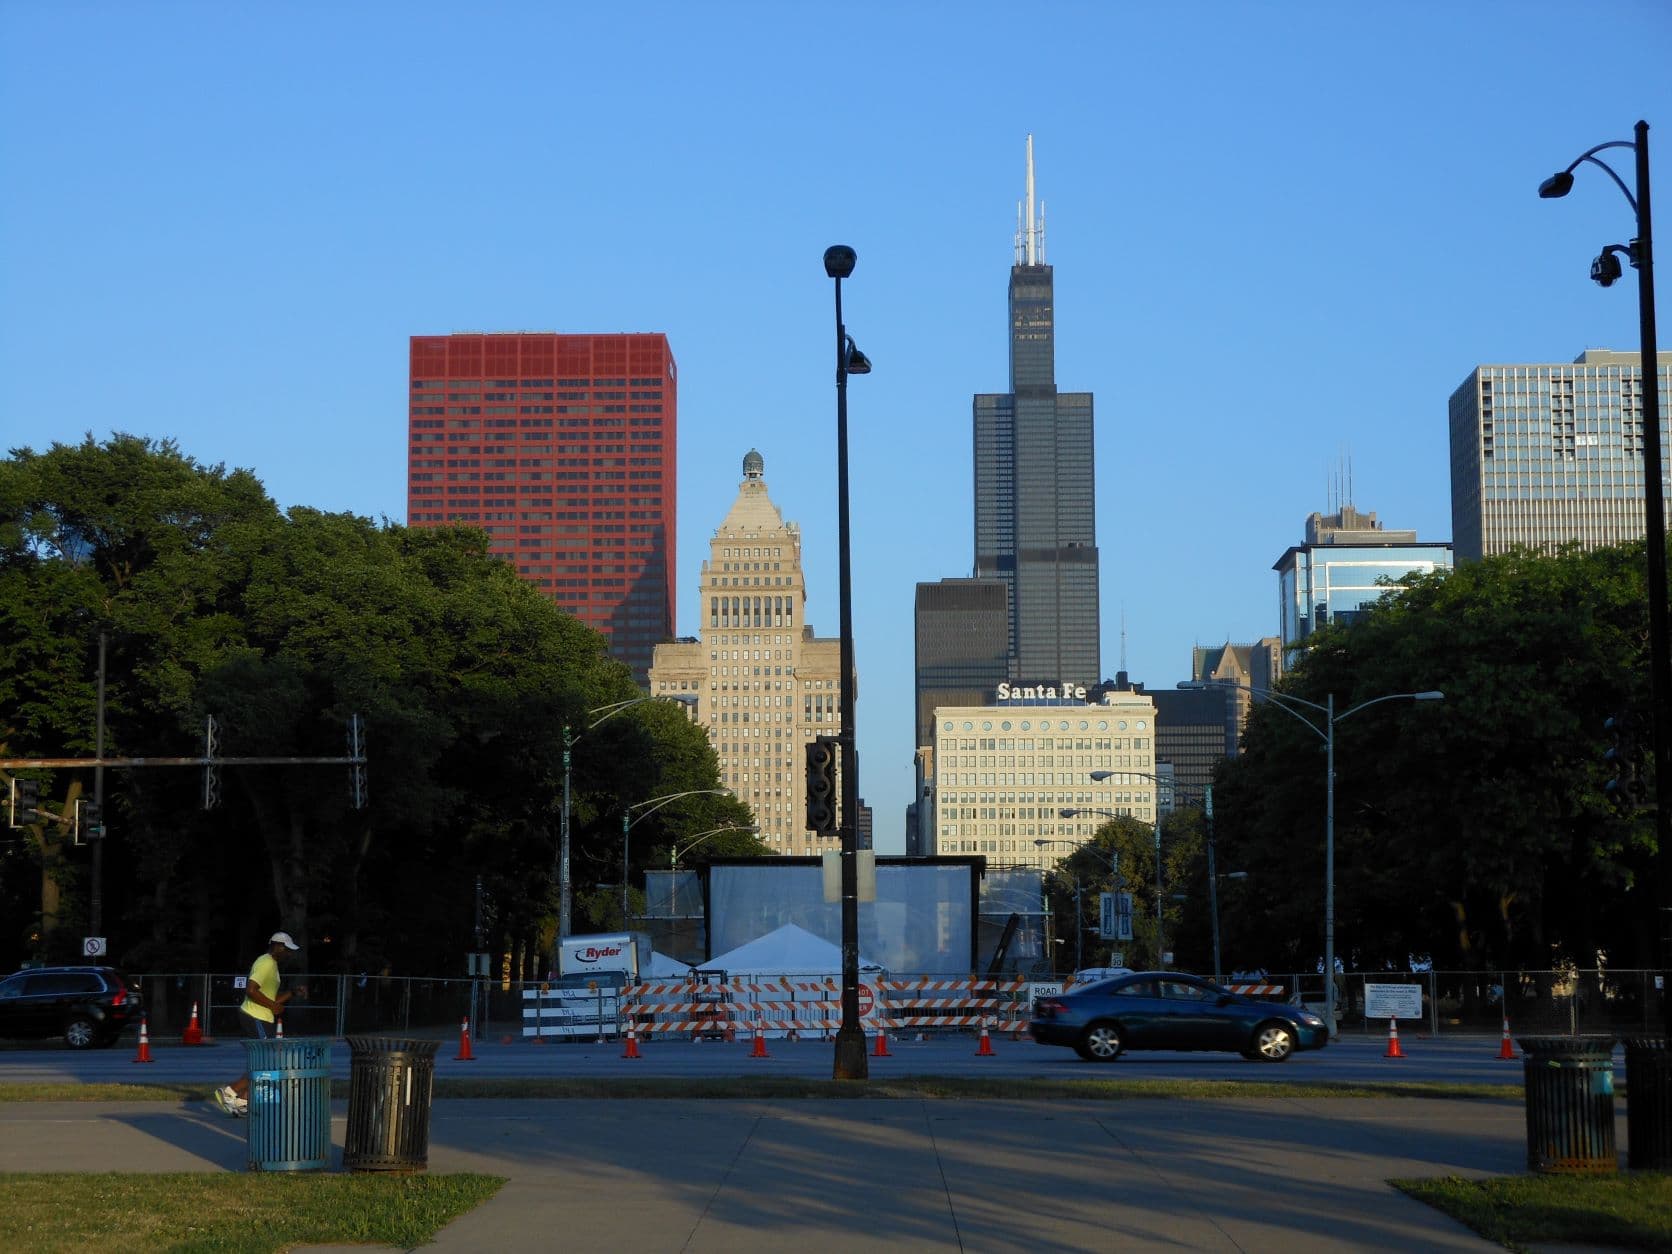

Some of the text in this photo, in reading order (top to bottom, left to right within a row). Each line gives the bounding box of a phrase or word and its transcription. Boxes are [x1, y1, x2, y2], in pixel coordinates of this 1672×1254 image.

[998, 682, 1087, 700] Santa Fe
[586, 946, 622, 959] Ryder
[1034, 987, 1057, 995] ROAD
